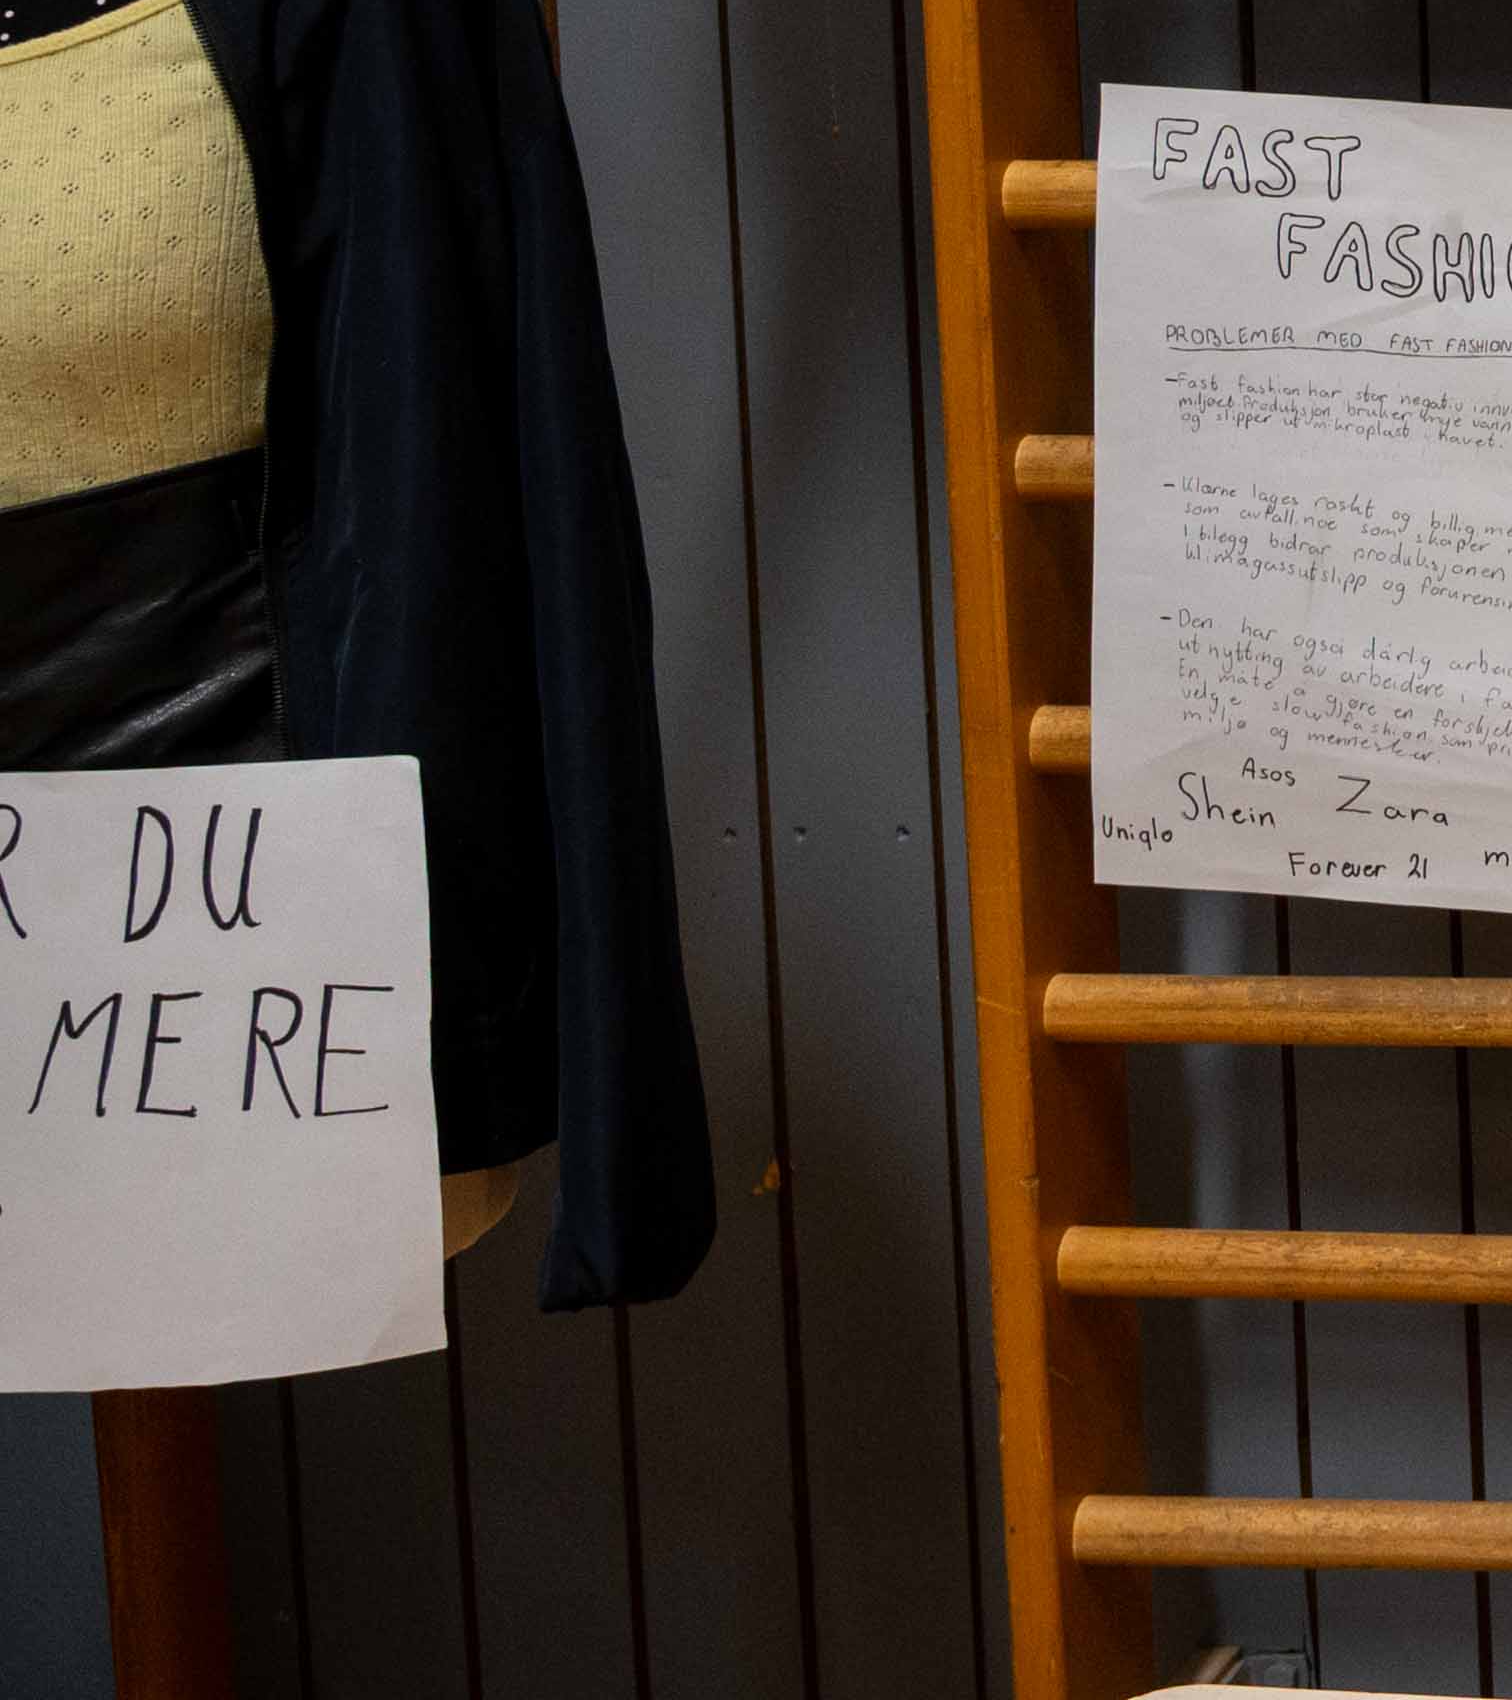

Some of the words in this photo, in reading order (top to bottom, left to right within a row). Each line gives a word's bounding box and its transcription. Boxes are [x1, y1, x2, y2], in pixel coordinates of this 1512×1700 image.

[1153, 118, 1362, 200] FAST
[1166, 324, 1294, 345] PROBLEMER
[1317, 330, 1362, 348] MED
[1390, 333, 1433, 351] FAST
[1446, 338, 1512, 353] FASHION
[1178, 768, 1282, 827] Shein
[1336, 775, 1448, 826] Zara
[1242, 757, 1295, 787] Asos
[123, 804, 263, 943] DU
[1288, 852, 1386, 878] Forever
[1408, 853, 1427, 879] 21
[28, 984, 394, 1118] MERE
